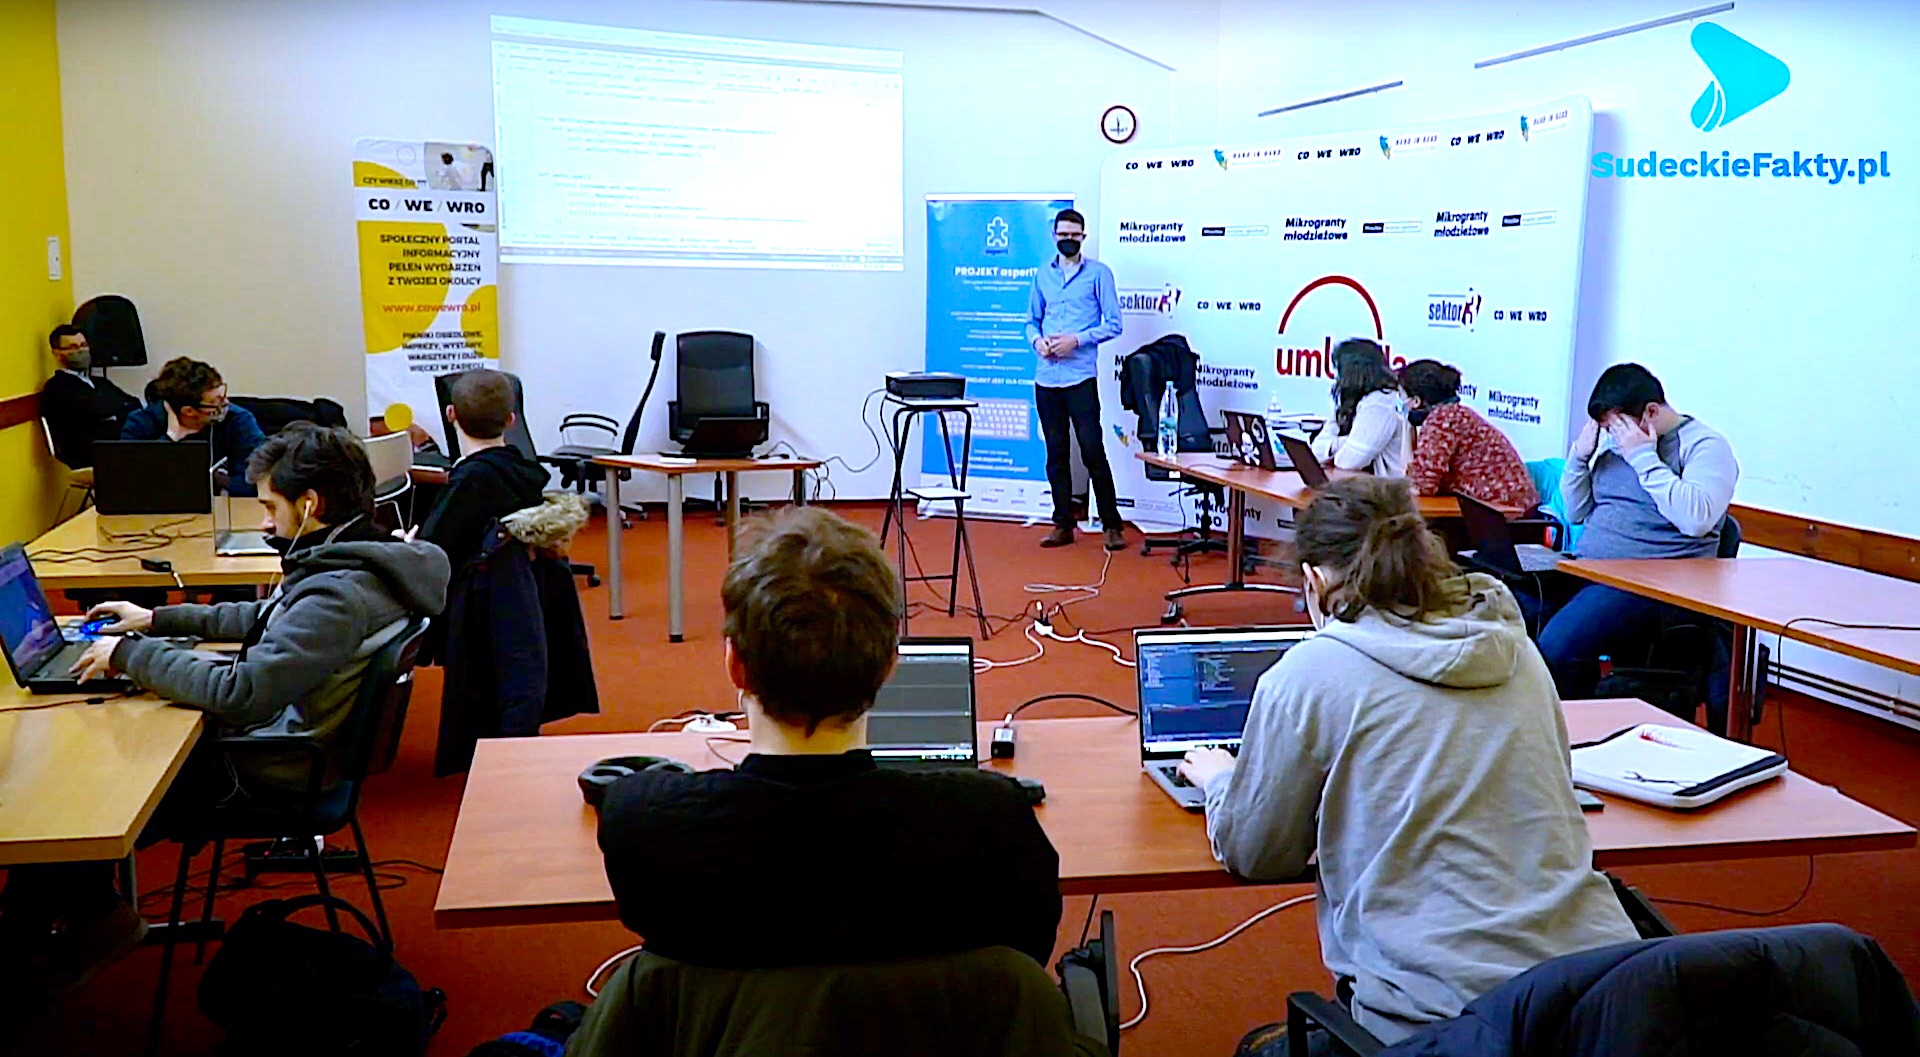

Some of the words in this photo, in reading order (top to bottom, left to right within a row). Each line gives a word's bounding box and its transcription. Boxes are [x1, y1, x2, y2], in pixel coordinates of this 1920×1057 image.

[1450, 136, 1462, 146] CO
[1297, 151, 1310, 160] CO
[1317, 149, 1332, 159] WE
[1339, 147, 1361, 157] WRO
[1125, 161, 1138, 170] CO
[1146, 160, 1162, 169] WE
[1170, 159, 1194, 168] WRO
[368, 198, 391, 210] CO
[404, 199, 433, 212] WE
[446, 201, 485, 214] WRO
[1436, 211, 1488, 226] Mikrogranty
[1120, 222, 1184, 234] Mikrogranty
[1286, 217, 1347, 233] Mikrogranty
[443, 236, 480, 245] PORTAL
[402, 249, 480, 258] INFORMACYJNY
[954, 266, 998, 277] PROJEKT
[388, 277, 395, 285] Z
[439, 277, 481, 286] OKOLICY
[1197, 301, 1209, 310] CO
[1216, 301, 1232, 310] WE
[1239, 302, 1261, 311] WRO
[1488, 389, 1539, 409] Mikrogranty
